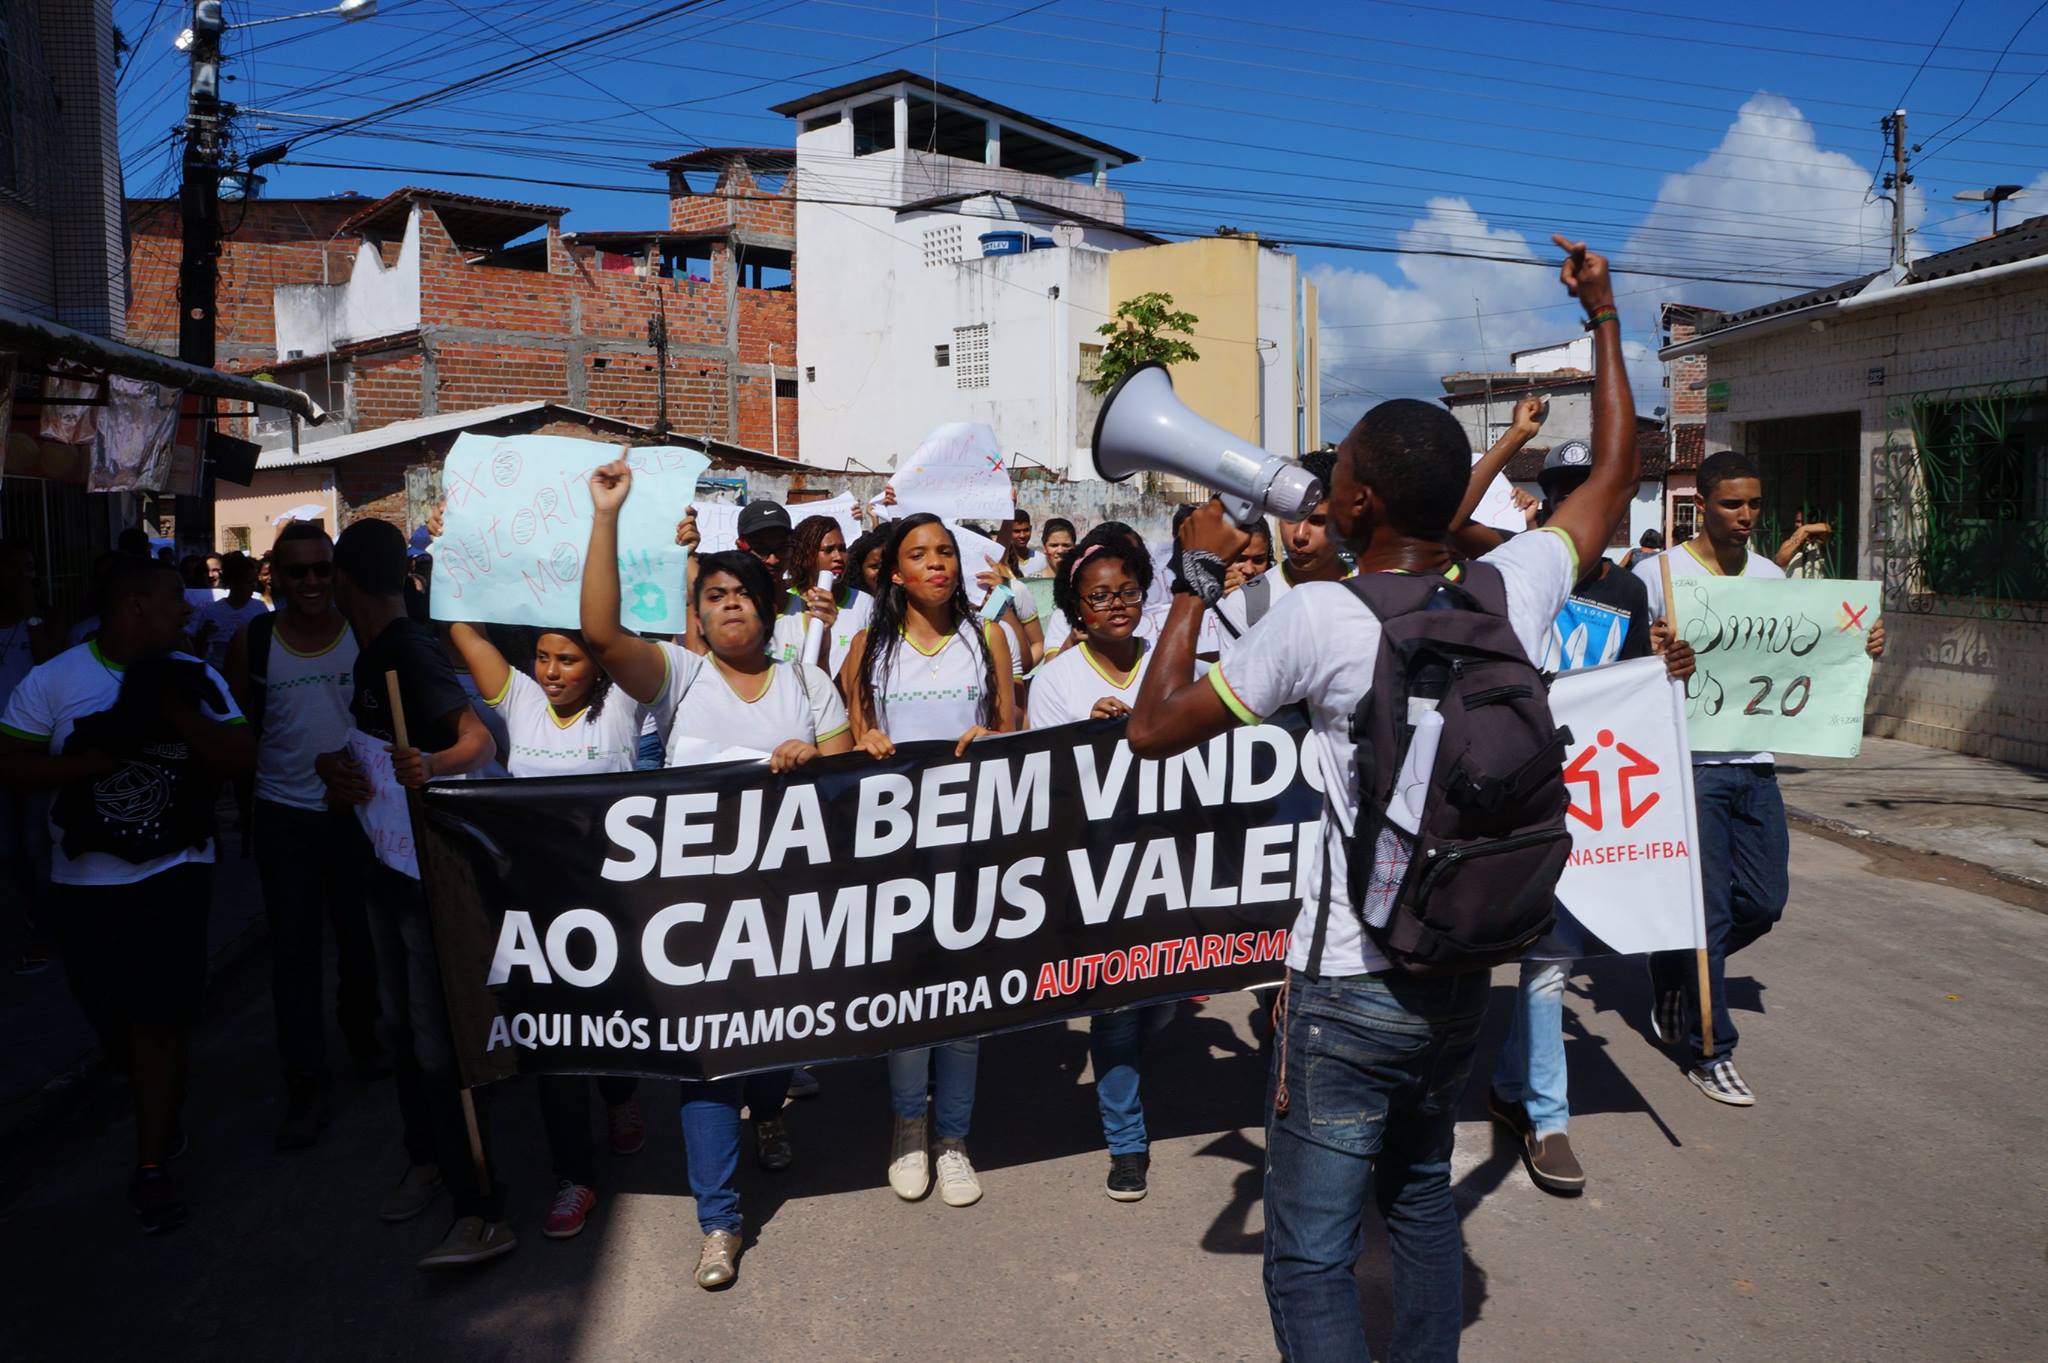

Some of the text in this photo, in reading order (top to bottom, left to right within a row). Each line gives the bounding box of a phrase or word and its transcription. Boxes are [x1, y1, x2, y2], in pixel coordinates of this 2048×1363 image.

[1684, 587, 1821, 656] Somos
[1744, 675, 1812, 718] 20
[601, 784, 831, 881] SEJA
[854, 750, 1051, 858] BEM
[1566, 840, 1689, 868] NASEFE-IFBA
[487, 908, 619, 988] AO
[641, 856, 1047, 986] CAMPUS
[486, 929, 1293, 1052] AQUI NÓS LUTAMOS CONTRA O AUTORITARISM
